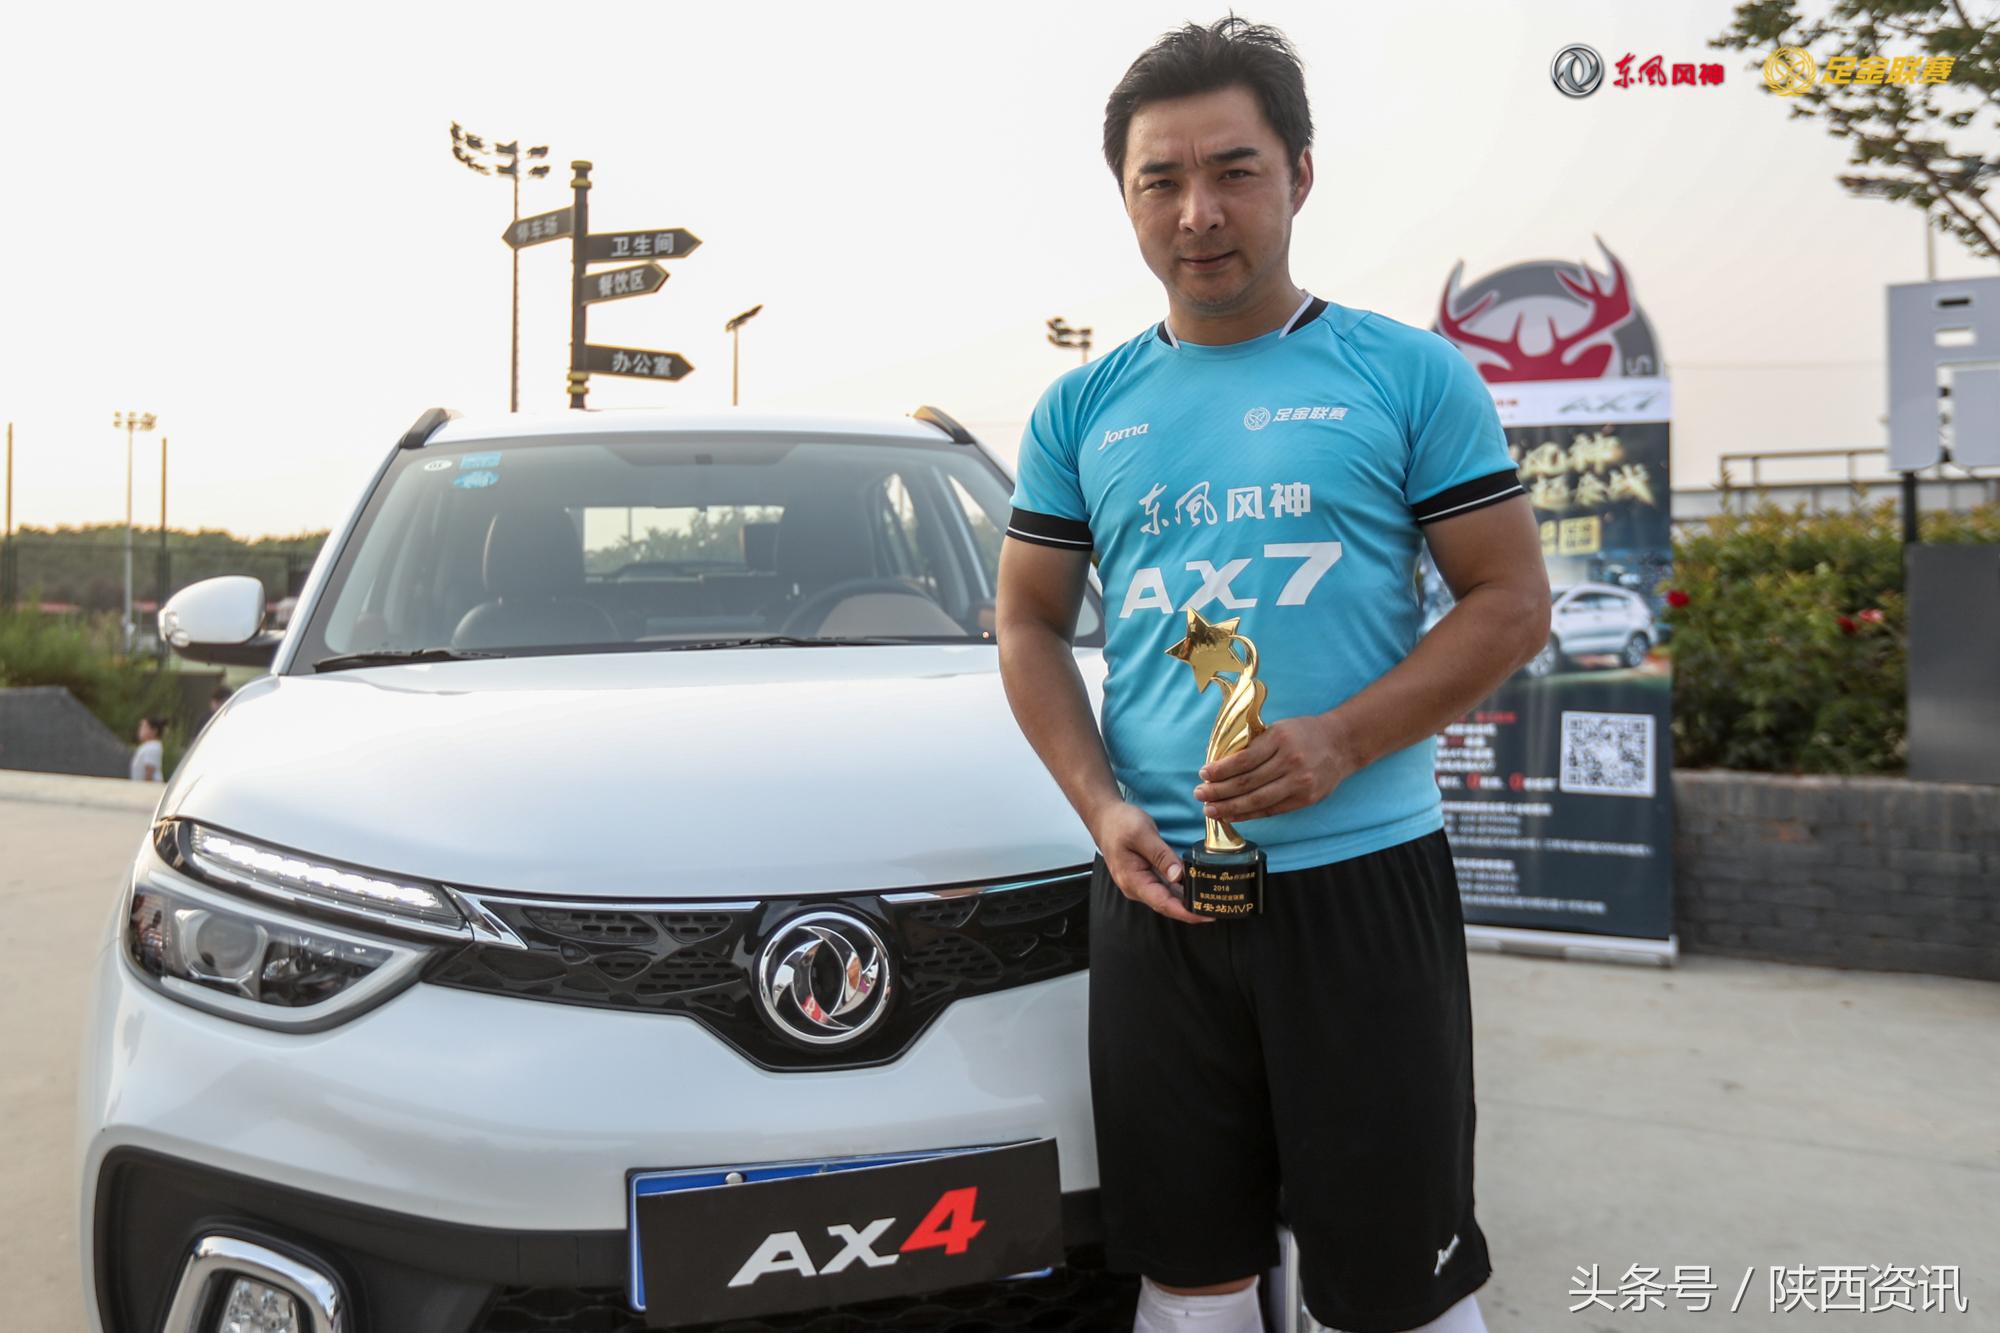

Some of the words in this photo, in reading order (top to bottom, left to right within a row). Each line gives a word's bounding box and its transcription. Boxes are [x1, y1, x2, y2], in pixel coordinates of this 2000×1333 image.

[611, 233, 674, 257] 卫生间
[598, 269, 645, 296] 餐饮区
[612, 351, 672, 376] 办公室
[1272, 407, 1348, 423] 足金联赛
[1098, 423, 1149, 450] Joma
[1138, 481, 1311, 535] 东风风神
[1119, 541, 1342, 618] AX7
[727, 1186, 986, 1287] AX4
